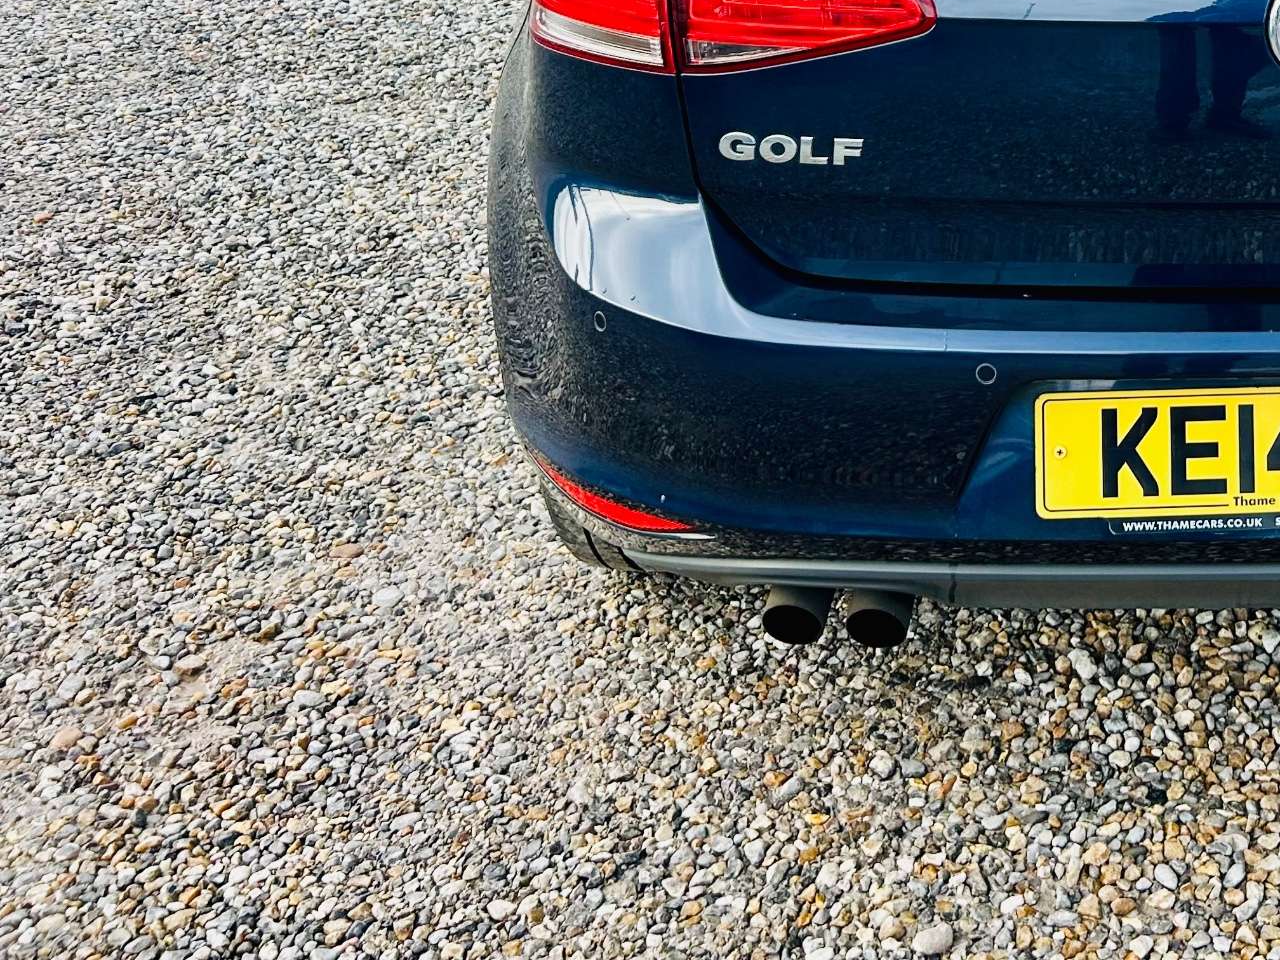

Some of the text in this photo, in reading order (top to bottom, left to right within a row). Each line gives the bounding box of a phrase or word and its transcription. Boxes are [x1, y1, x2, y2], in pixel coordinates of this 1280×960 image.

[718, 131, 865, 166] GOLF
[1233, 494, 1277, 507] Thame
[1122, 516, 1263, 532] WWW.THAMECARS.CO.UK
